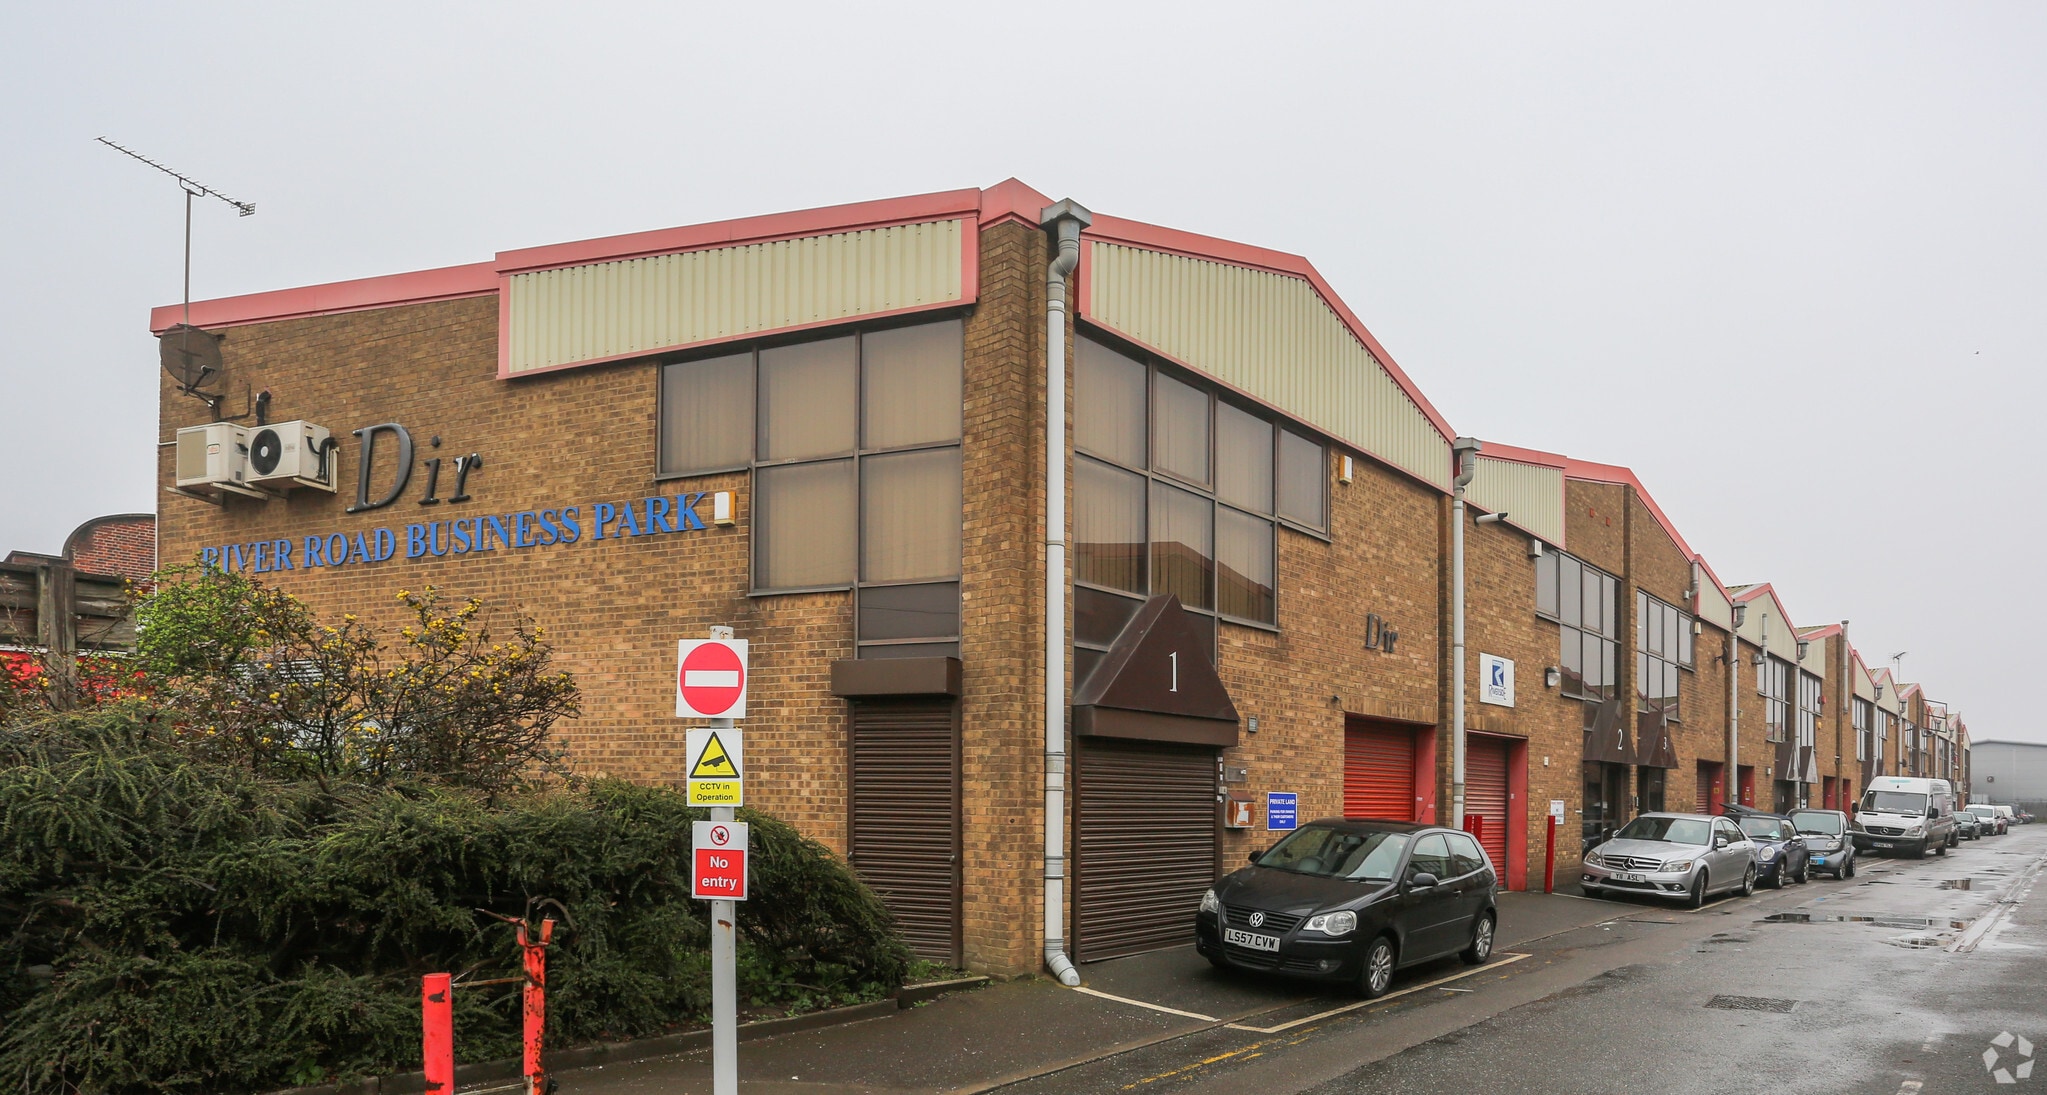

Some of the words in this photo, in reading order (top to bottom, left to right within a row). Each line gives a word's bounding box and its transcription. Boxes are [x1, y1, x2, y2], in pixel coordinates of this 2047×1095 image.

[346, 422, 482, 513] Dir
[201, 539, 295, 577] RIVER
[303, 528, 396, 569] ROAD
[405, 506, 582, 558] BUSINESS
[592, 492, 708, 540] PARK
[1365, 612, 1398, 653] Dir
[1169, 651, 1177, 692] 1
[1617, 728, 1623, 750] 2
[696, 794, 734, 802] Operation
[709, 856, 729, 869] No
[701, 876, 737, 891] entry
[1228, 930, 1253, 944] LS57
[1255, 935, 1276, 949] CVW
